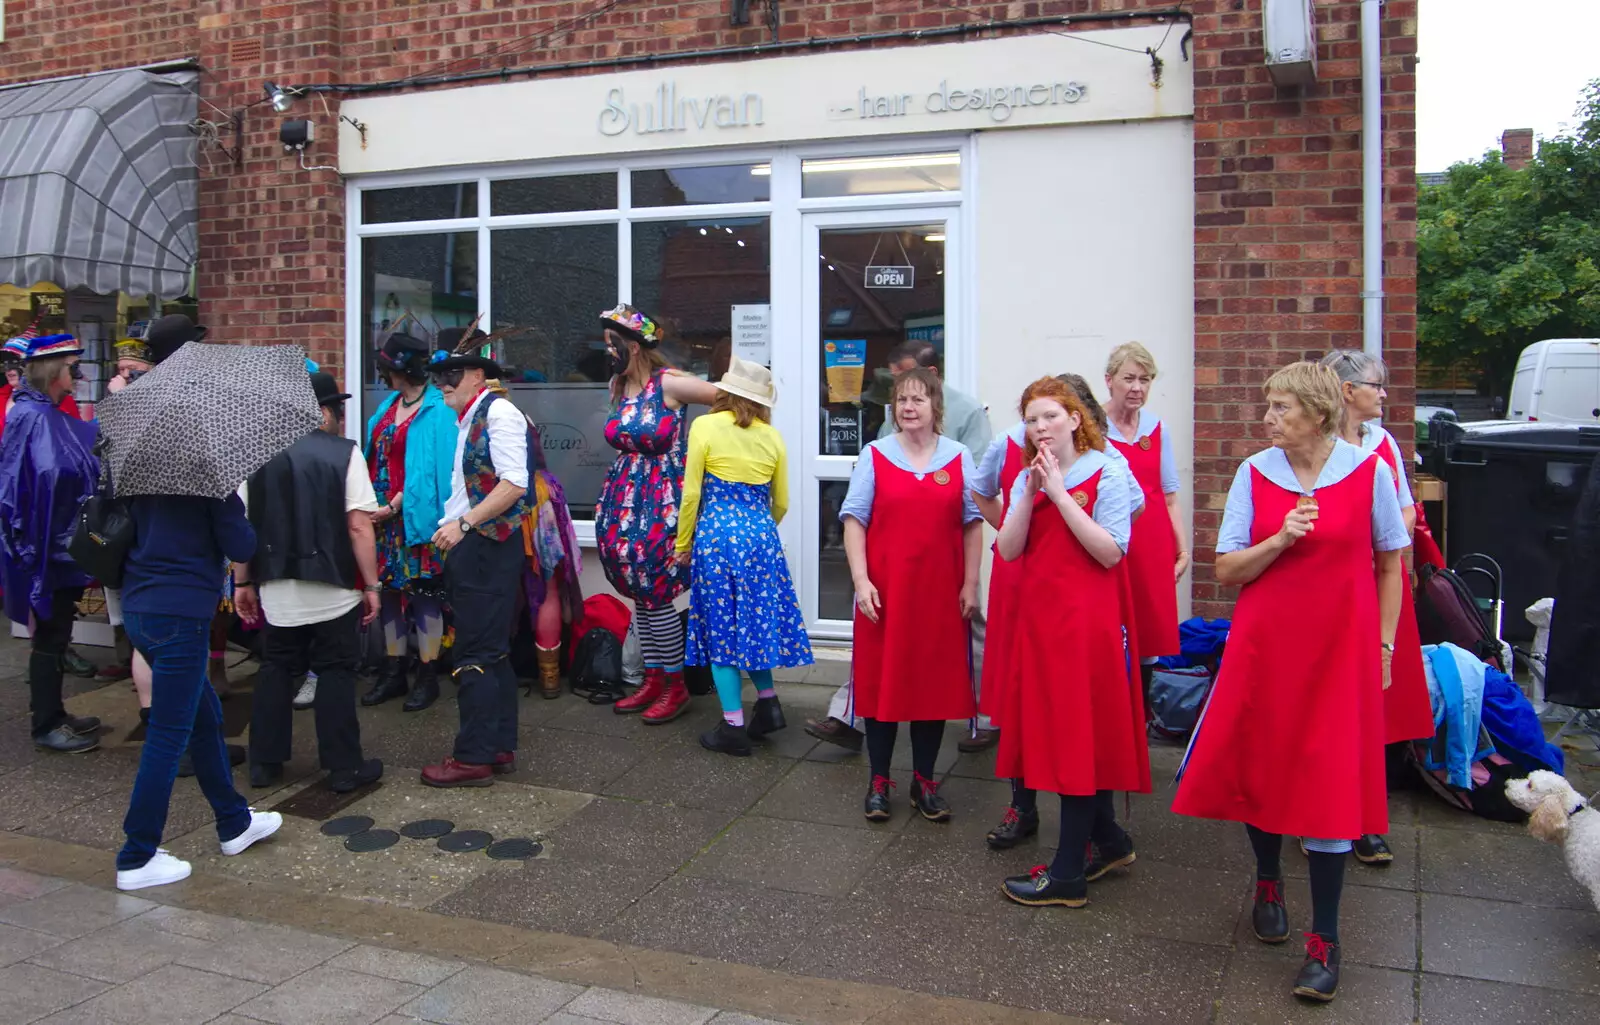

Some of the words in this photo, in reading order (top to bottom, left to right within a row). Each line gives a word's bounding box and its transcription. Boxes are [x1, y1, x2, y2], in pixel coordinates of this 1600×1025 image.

[597, 80, 766, 136] Sullivan
[858, 85, 913, 119] hair
[926, 79, 1084, 122] designers
[874, 273, 905, 286] OPEN
[831, 430, 859, 441] 2018
